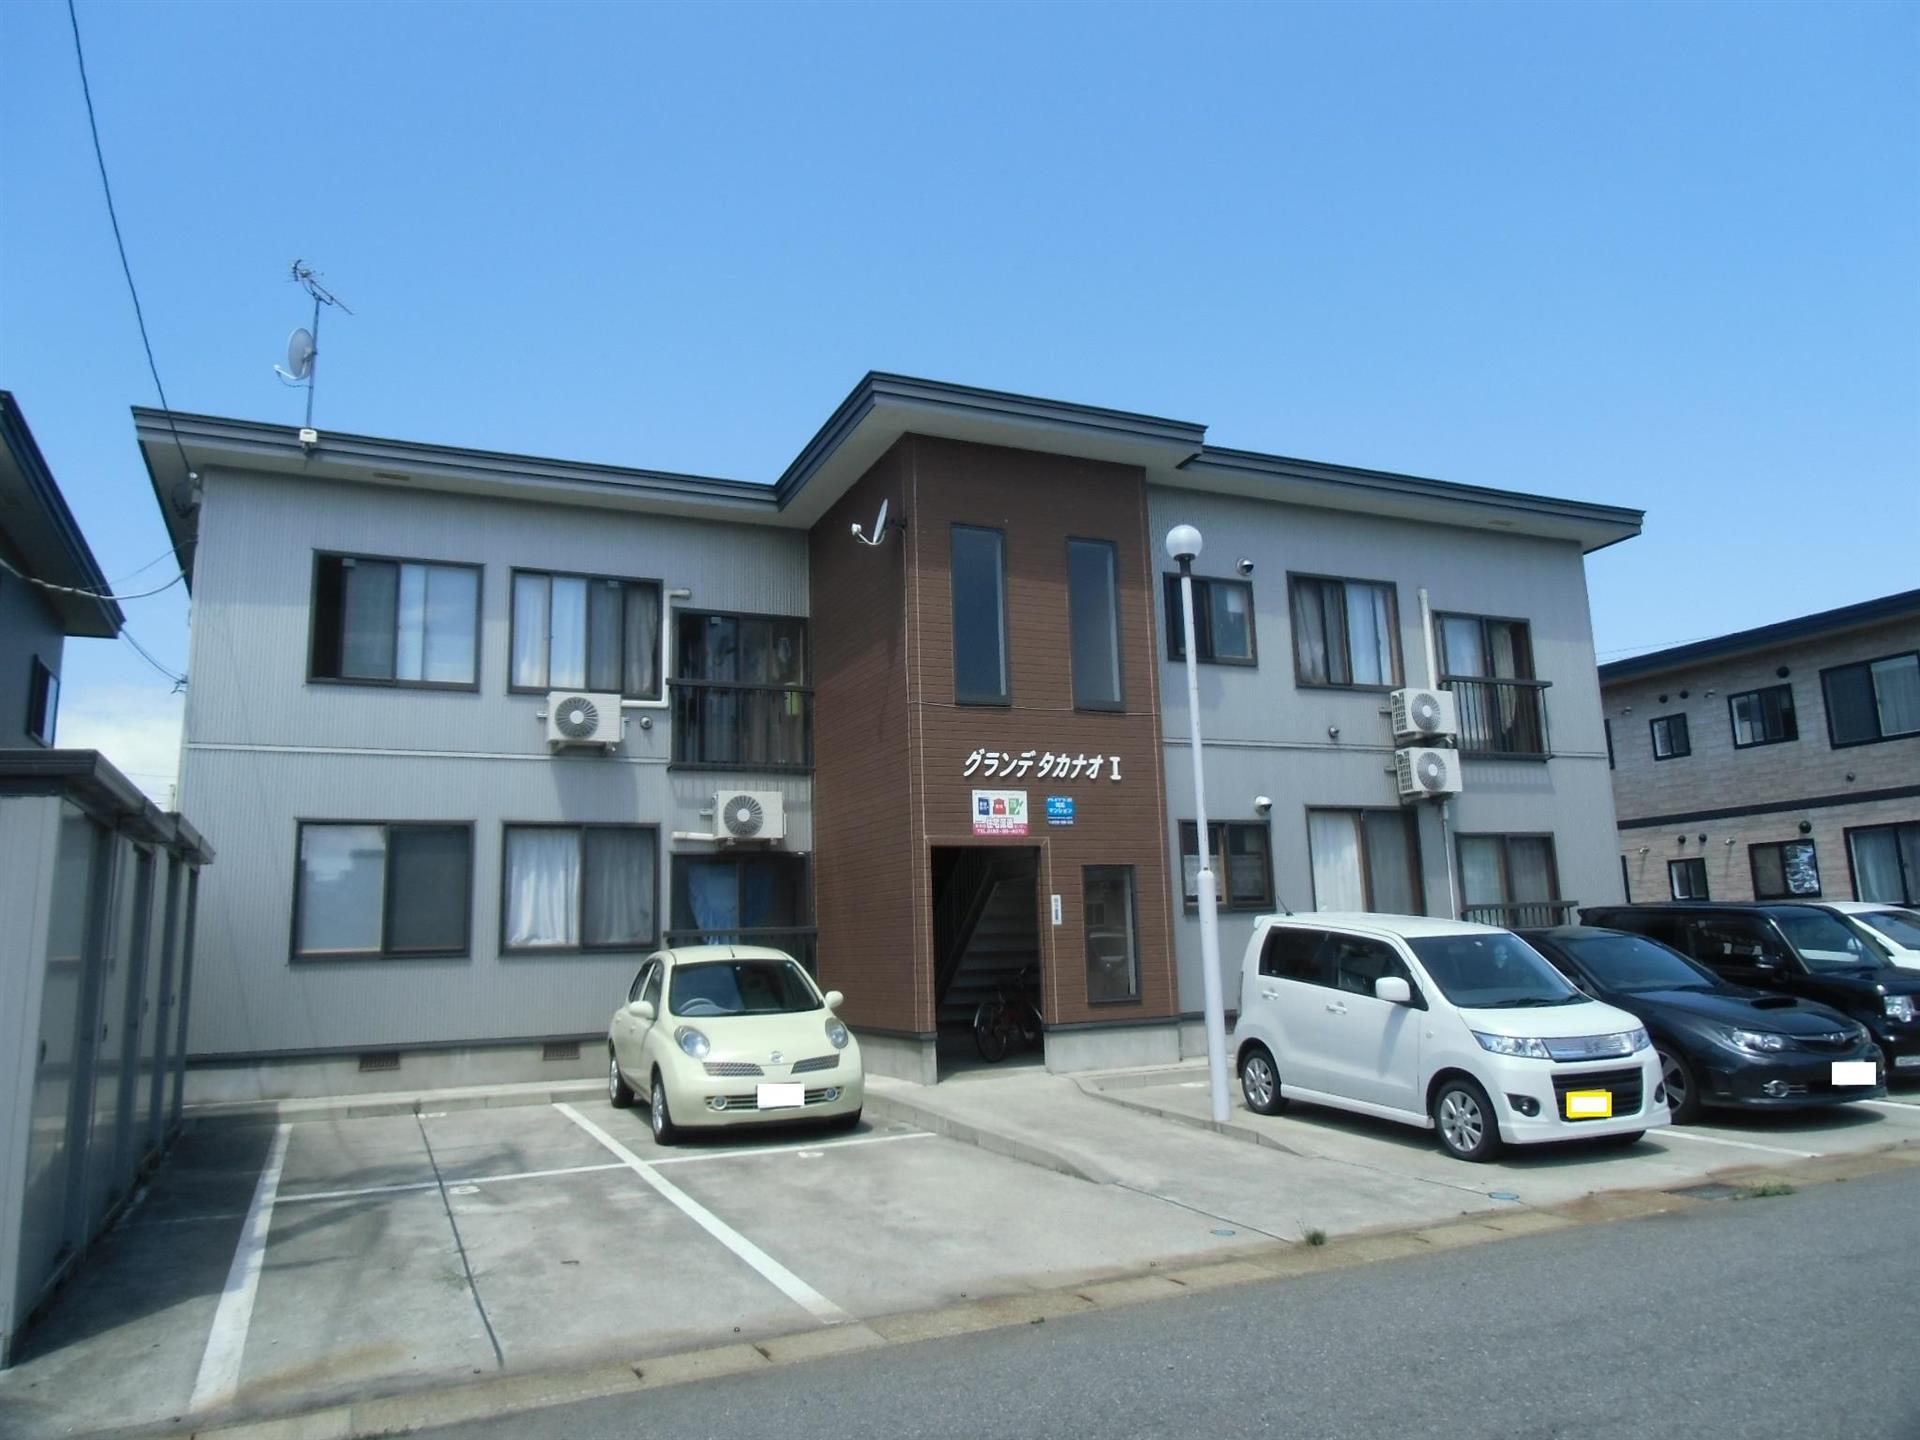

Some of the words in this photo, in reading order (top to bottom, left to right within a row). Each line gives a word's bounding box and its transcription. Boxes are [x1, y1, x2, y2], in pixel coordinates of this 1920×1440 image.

[963, 748, 1037, 777] グランデ
[1037, 751, 1104, 779] タカナオ
